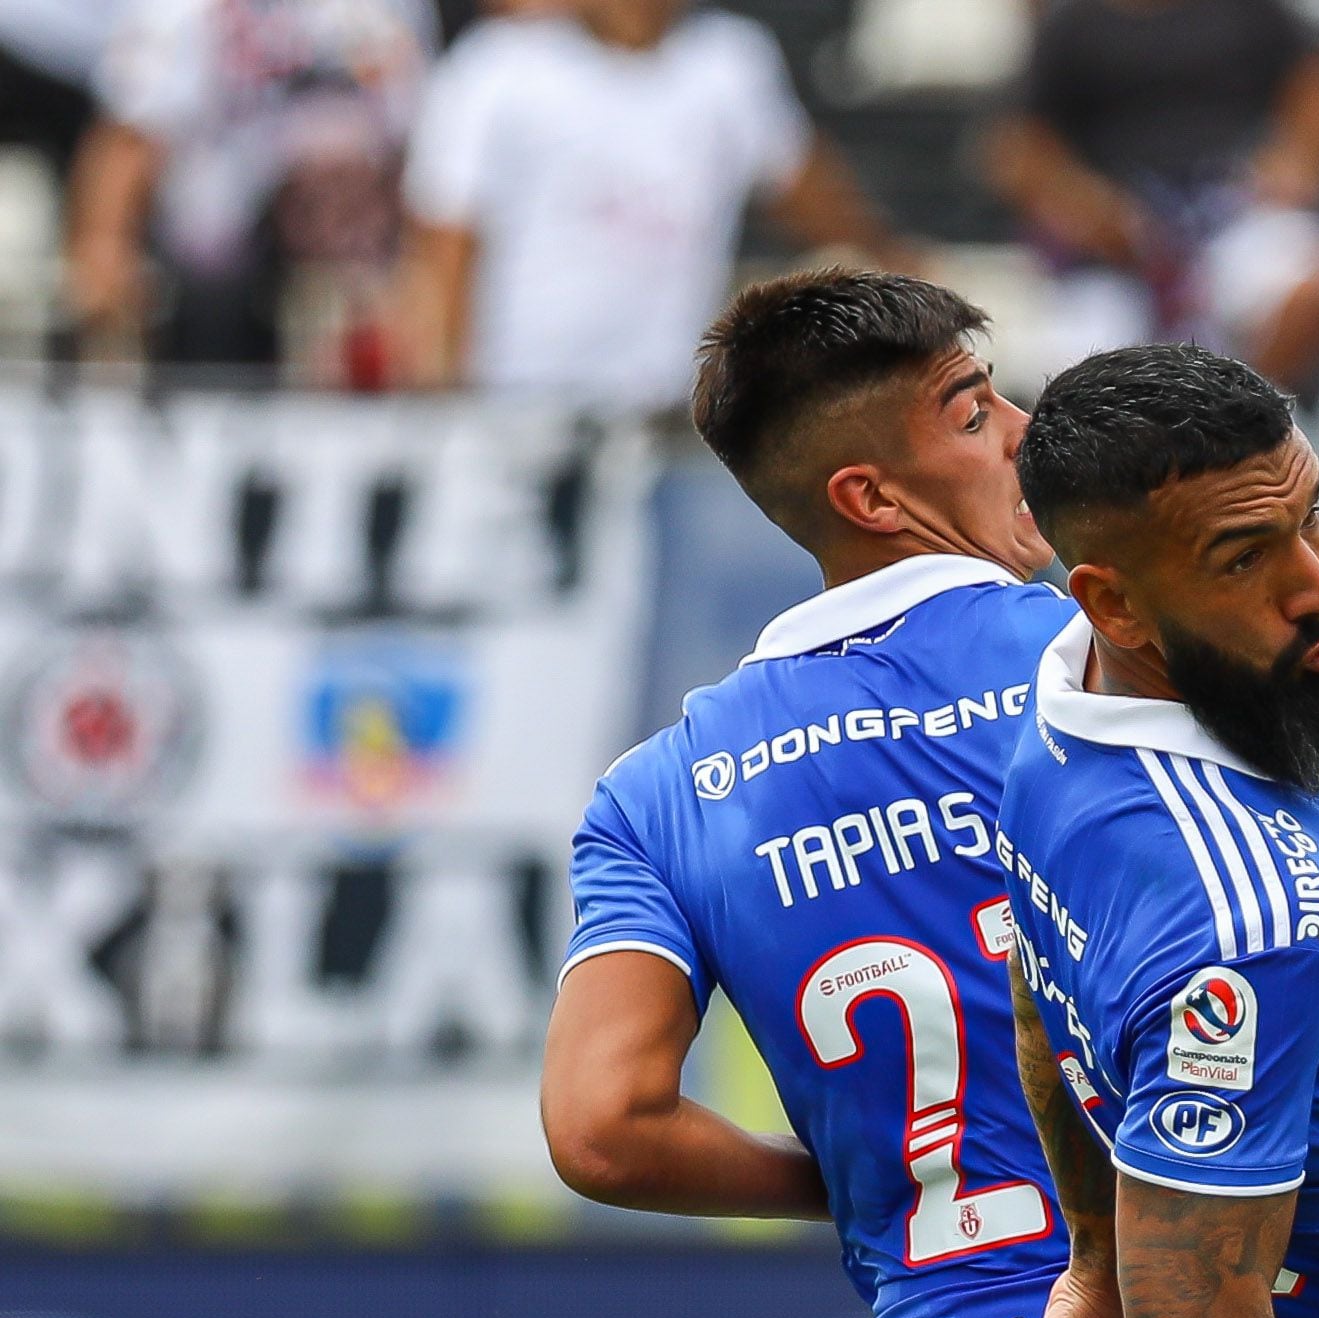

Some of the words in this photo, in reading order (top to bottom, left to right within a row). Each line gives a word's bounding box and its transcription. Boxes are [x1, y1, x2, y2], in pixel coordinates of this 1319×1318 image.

[754, 792, 992, 908] TAPIAS
[995, 820, 1088, 963] GFENG
[1172, 1046, 1248, 1066] Campeonato
[1181, 1060, 1239, 1082] PlanVital
[1172, 1103, 1222, 1143] PF
